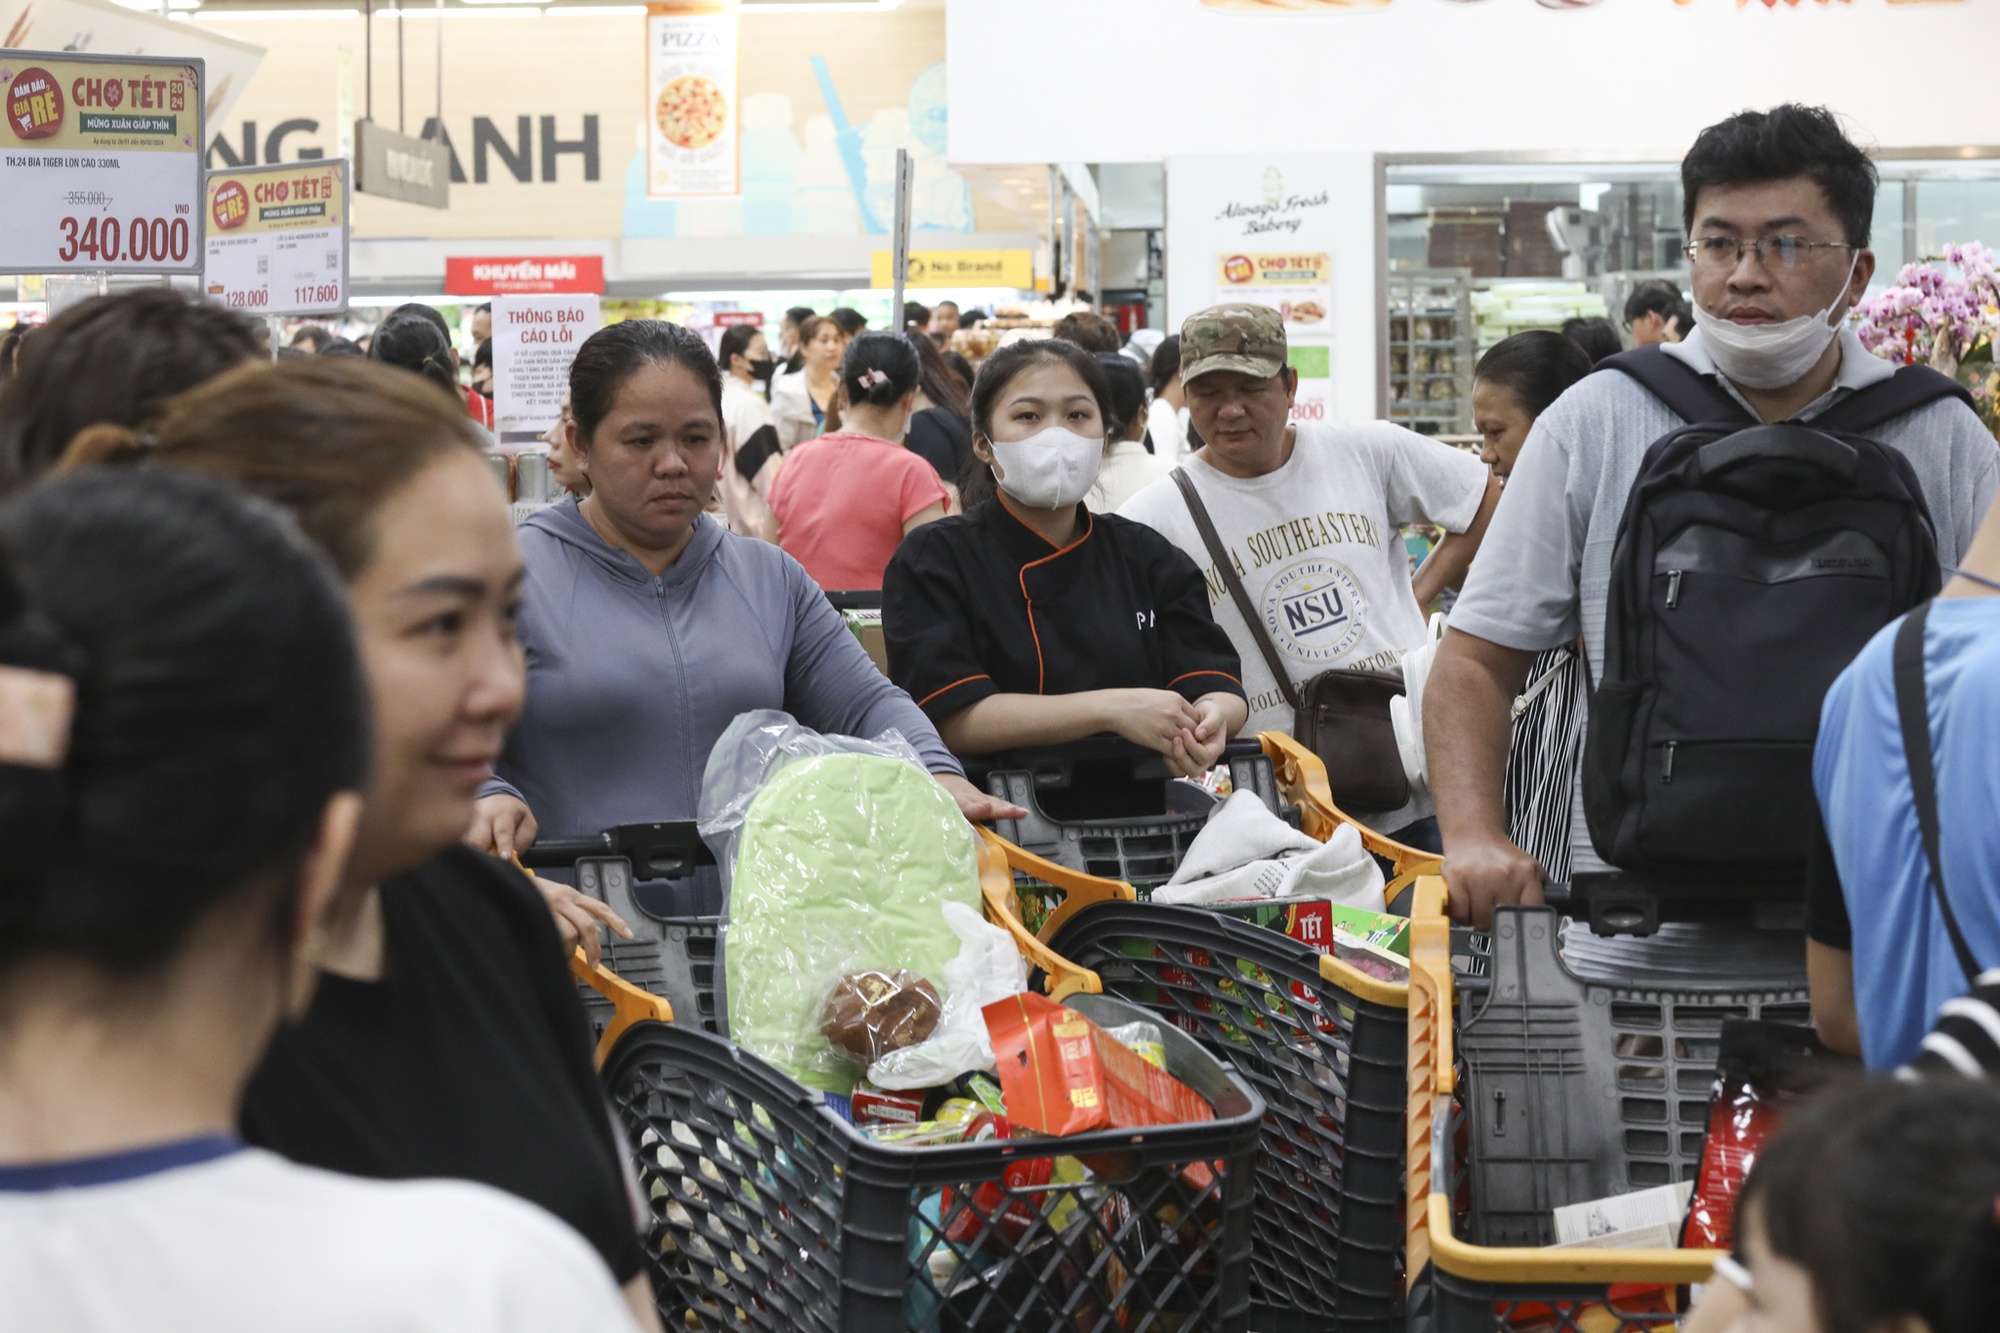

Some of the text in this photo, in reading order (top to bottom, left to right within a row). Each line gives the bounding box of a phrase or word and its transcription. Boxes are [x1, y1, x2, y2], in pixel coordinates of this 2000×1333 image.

[662, 32, 720, 47] PIZZA
[72, 74, 167, 111] CHỢ TẾT
[171, 82, 183, 92] 20
[13, 84, 59, 126] GIÁ RẺ
[171, 100, 183, 109] 24
[87, 117, 170, 130] MỪNG XUÂN GIÁP THÌN
[6, 156, 121, 170] TH.24 BIA TIGER LON CAO 330ML
[68, 191, 105, 205] 355.000
[59, 216, 189, 262] 340.000
[473, 260, 542, 280] KHUYẾN
[931, 260, 1003, 271] No Brand
[226, 290, 269, 308] 128.000
[295, 285, 338, 303] 117.600
[508, 307, 585, 324] THÔNG BÁO
[521, 324, 573, 344] CÁO LỖI
[1206, 511, 1382, 607] NOA SOUTHEASTERN
[1266, 597, 1279, 634] NOVA
[1284, 587, 1344, 631] NSU
[1286, 621, 1362, 659] UNIVERSITY
[1300, 911, 1322, 940] TẾT
